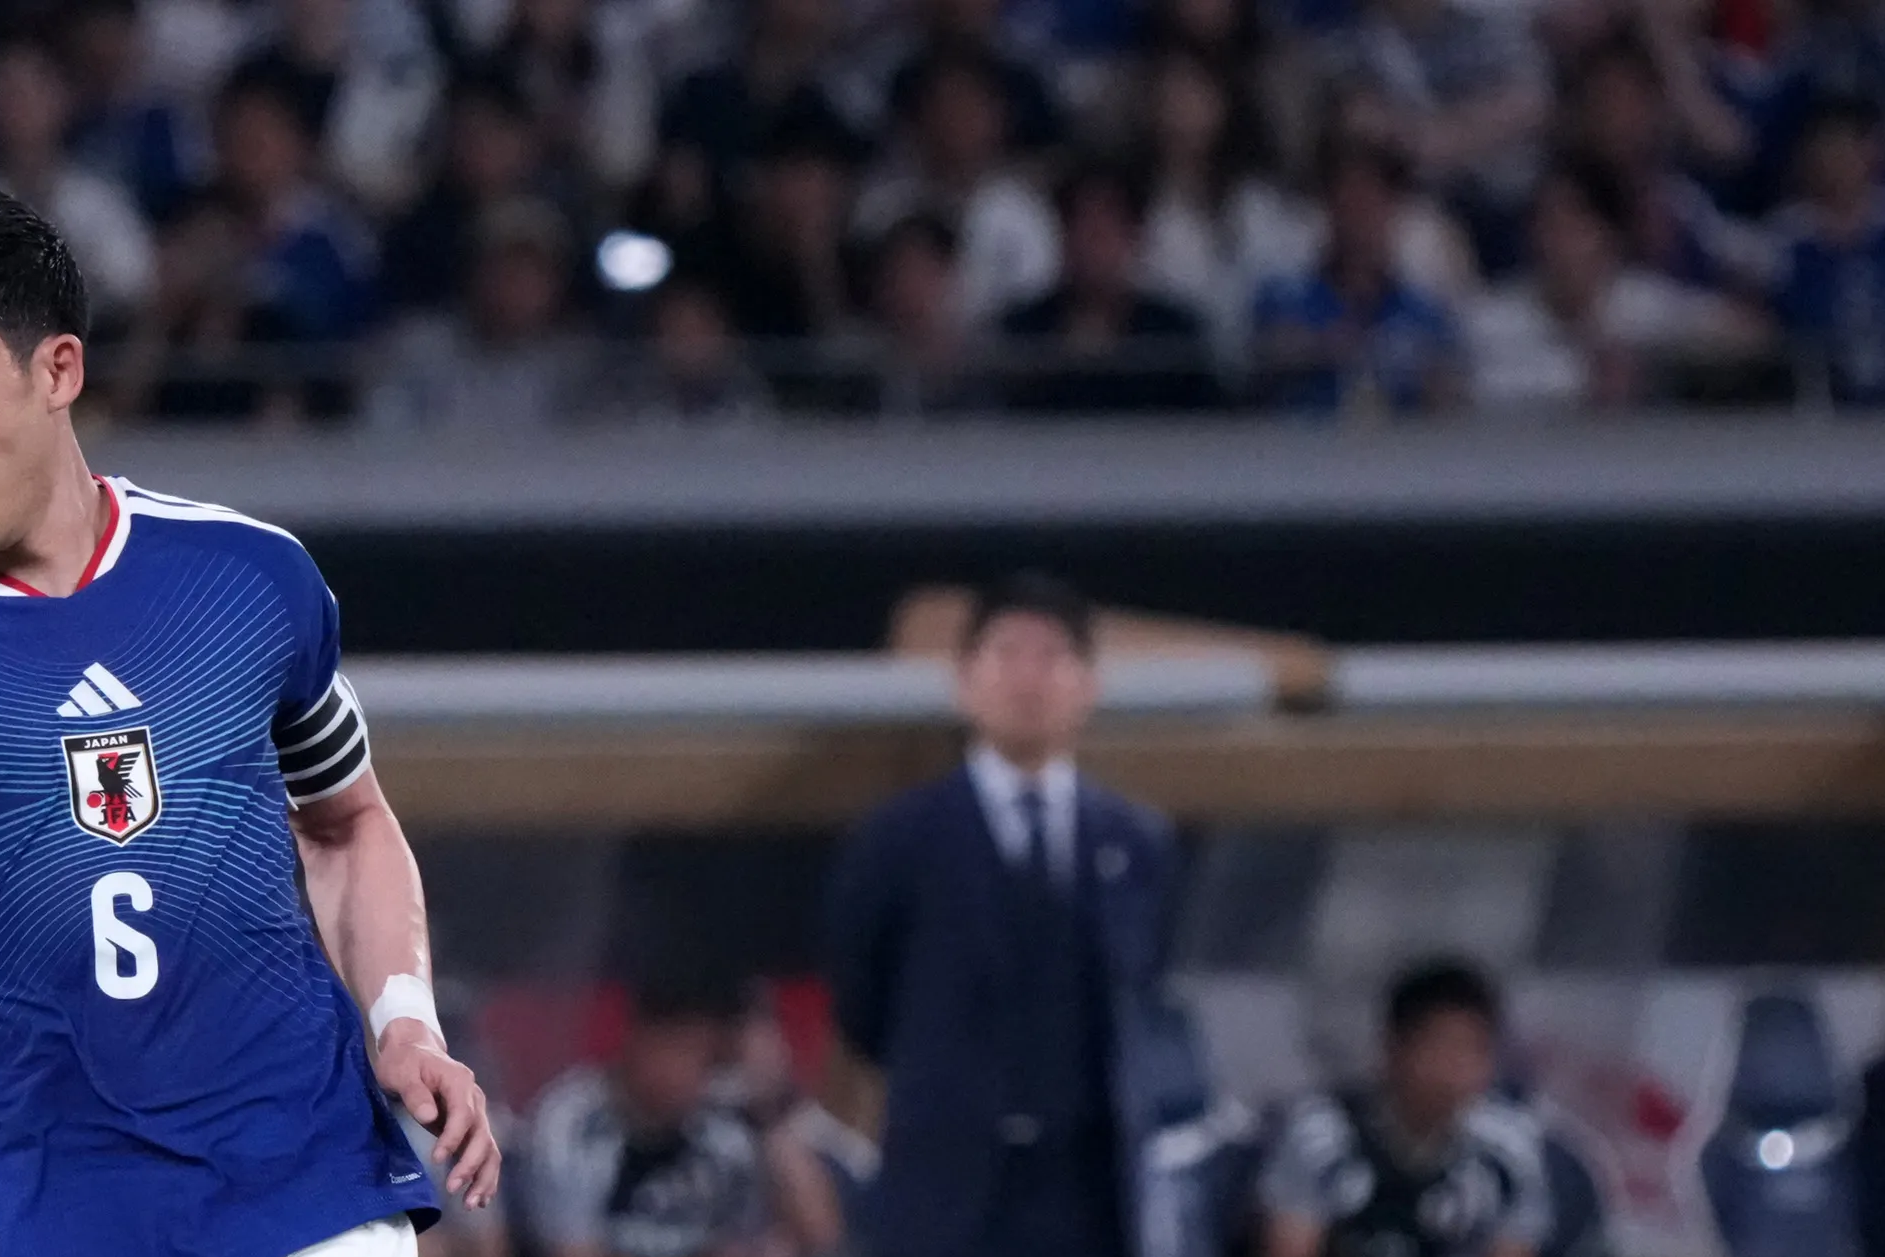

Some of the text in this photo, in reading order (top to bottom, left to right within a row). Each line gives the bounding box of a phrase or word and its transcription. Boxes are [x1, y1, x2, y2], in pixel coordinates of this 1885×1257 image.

[84, 735, 128, 749] JAPAN
[98, 806, 137, 825] JFA
[91, 872, 159, 1000] 6
